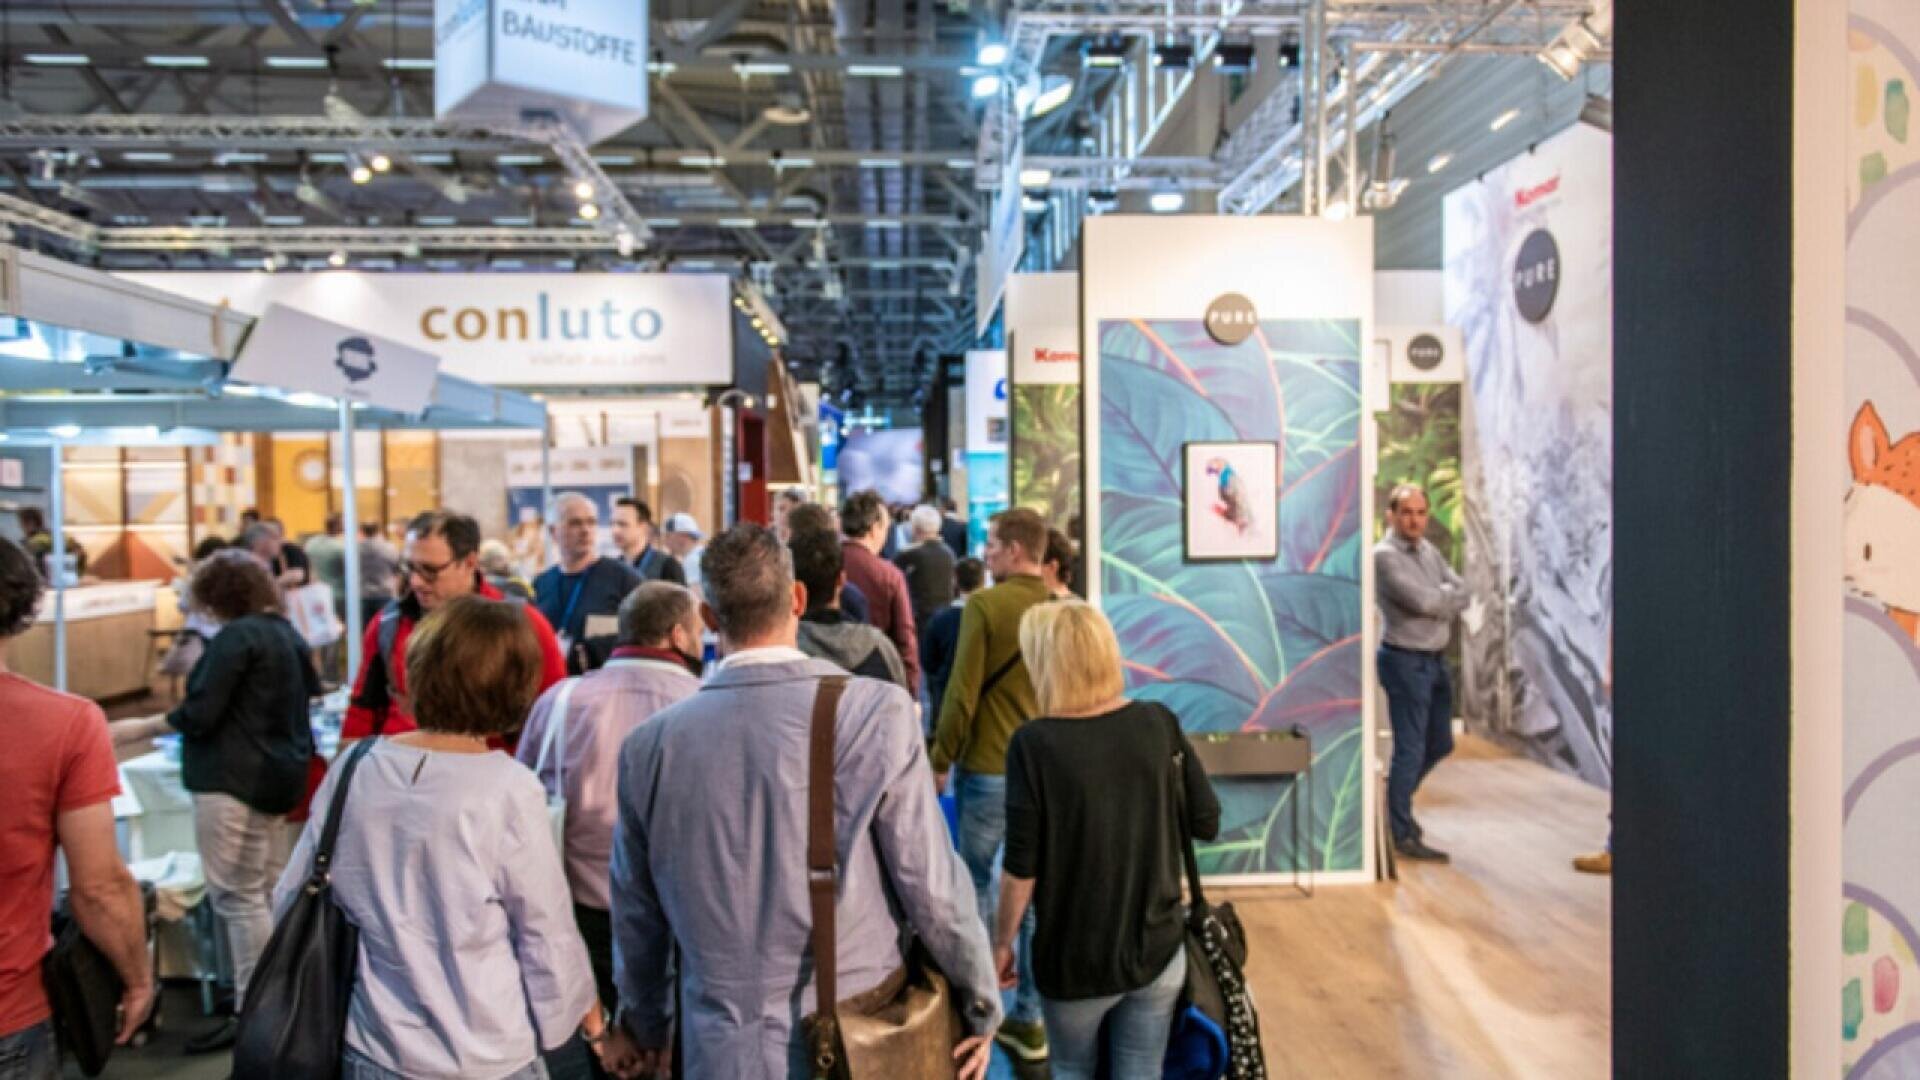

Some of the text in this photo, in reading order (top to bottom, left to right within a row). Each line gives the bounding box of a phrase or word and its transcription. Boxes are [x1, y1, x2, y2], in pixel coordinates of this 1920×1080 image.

[503, 9, 637, 66] BAUSTOFFE
[1514, 257, 1556, 289] PURE
[420, 291, 663, 341] conluto
[1210, 310, 1256, 325] PURE
